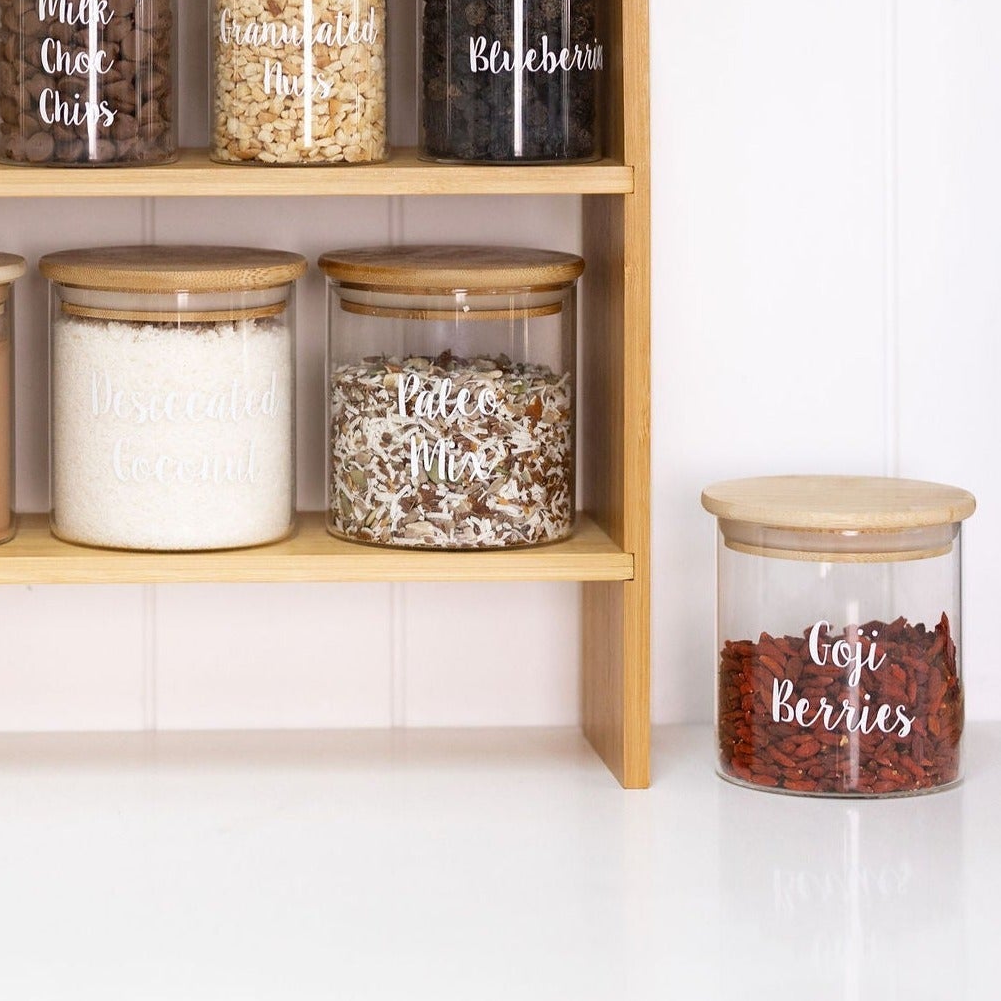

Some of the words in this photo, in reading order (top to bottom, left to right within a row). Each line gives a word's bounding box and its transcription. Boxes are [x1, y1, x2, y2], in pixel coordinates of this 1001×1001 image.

[41, 37, 115, 76] Choc
[39, 87, 118, 133] Chips
[398, 373, 504, 421] Paleo
[112, 437, 261, 484] Coconut
[410, 434, 505, 483] Mix
[808, 620, 887, 687] Goji
[772, 677, 916, 738] Berries
